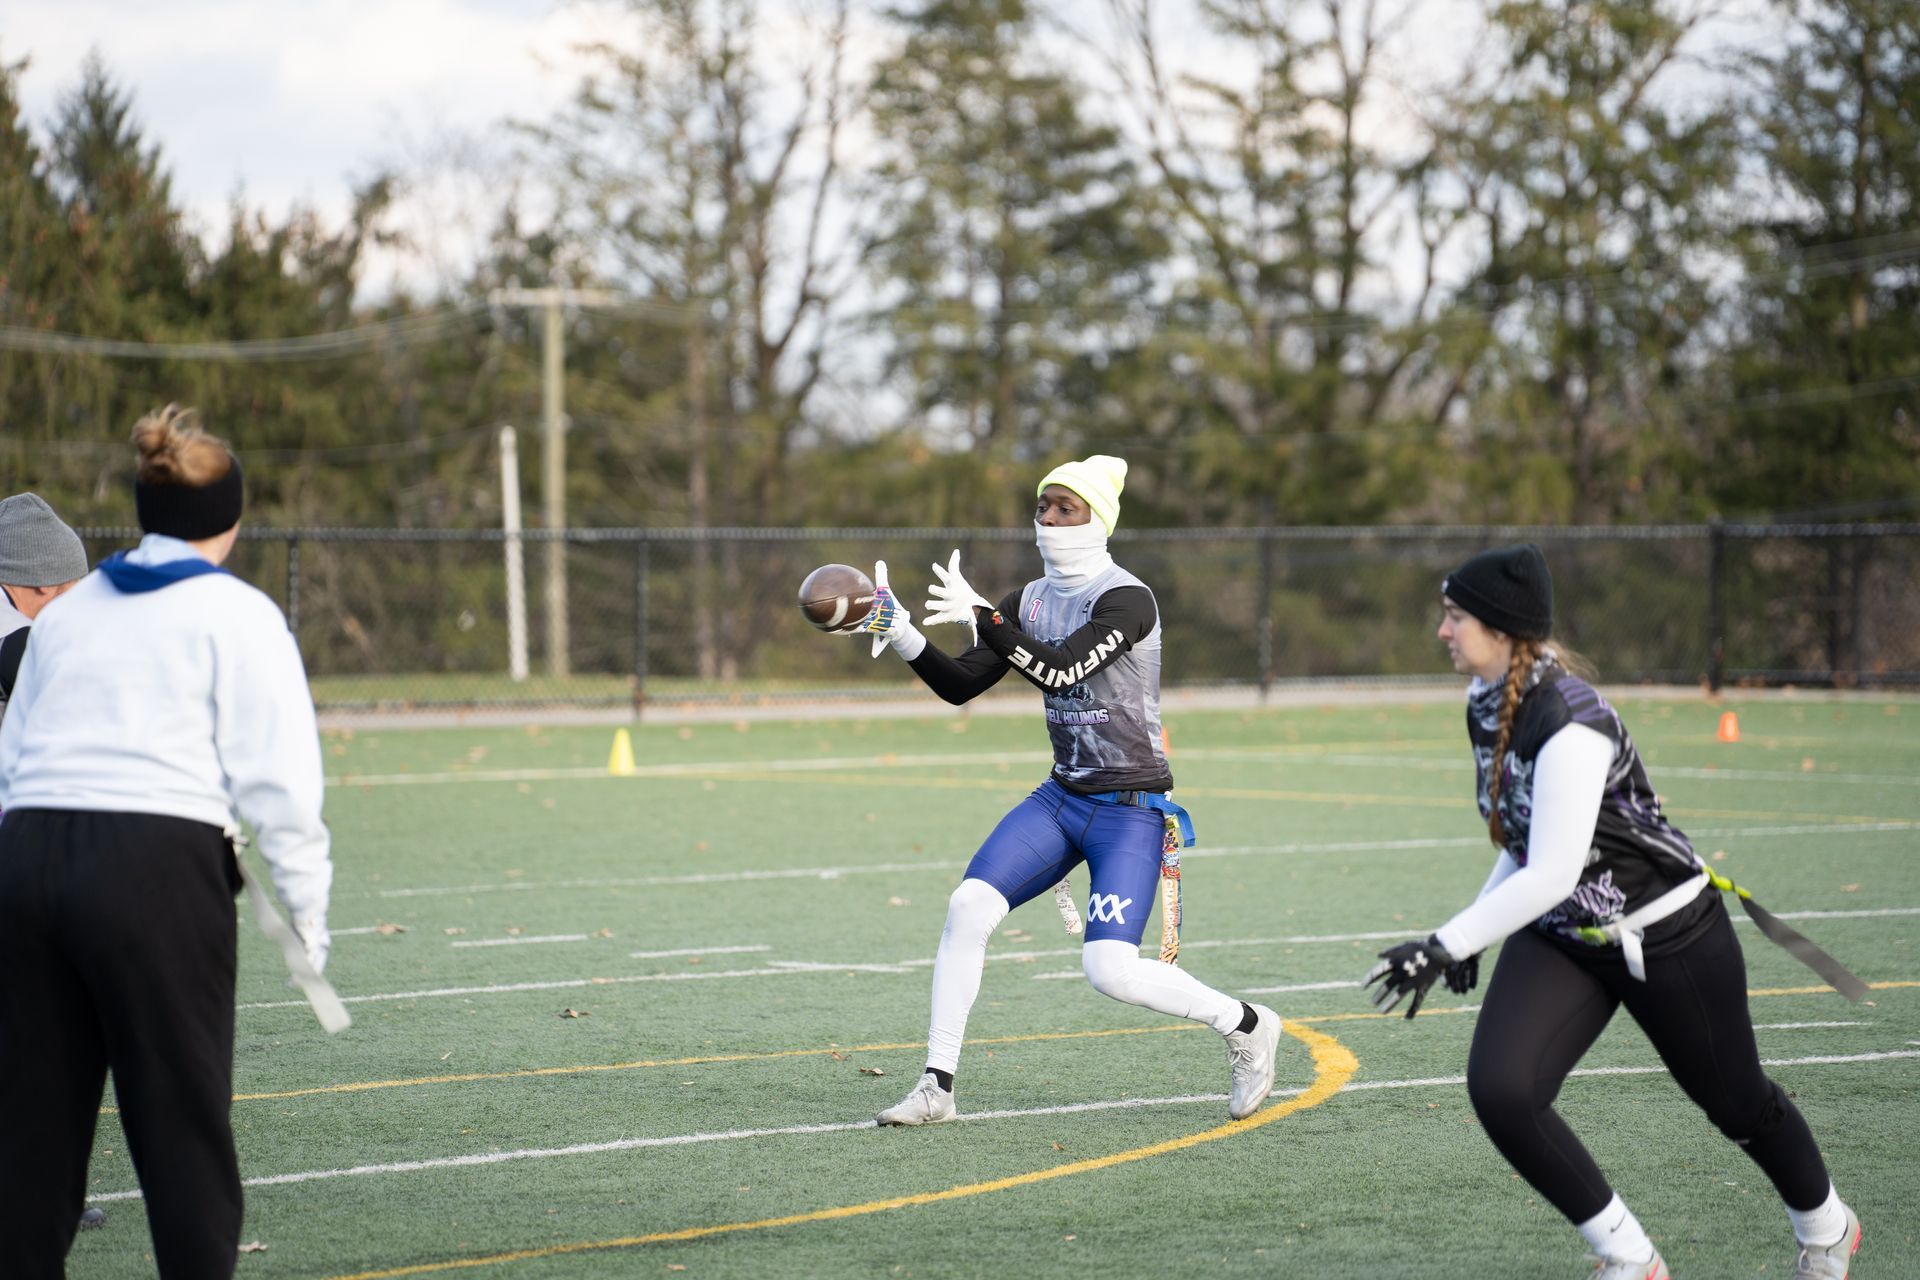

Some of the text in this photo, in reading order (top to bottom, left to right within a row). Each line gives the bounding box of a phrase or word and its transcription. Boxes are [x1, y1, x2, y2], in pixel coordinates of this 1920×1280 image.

[1029, 598, 1042, 622] 1
[1007, 629, 1125, 688] INFINITE
[1063, 708, 1110, 726] HOUNDS
[1164, 878, 1175, 944] CHAMPIONS
